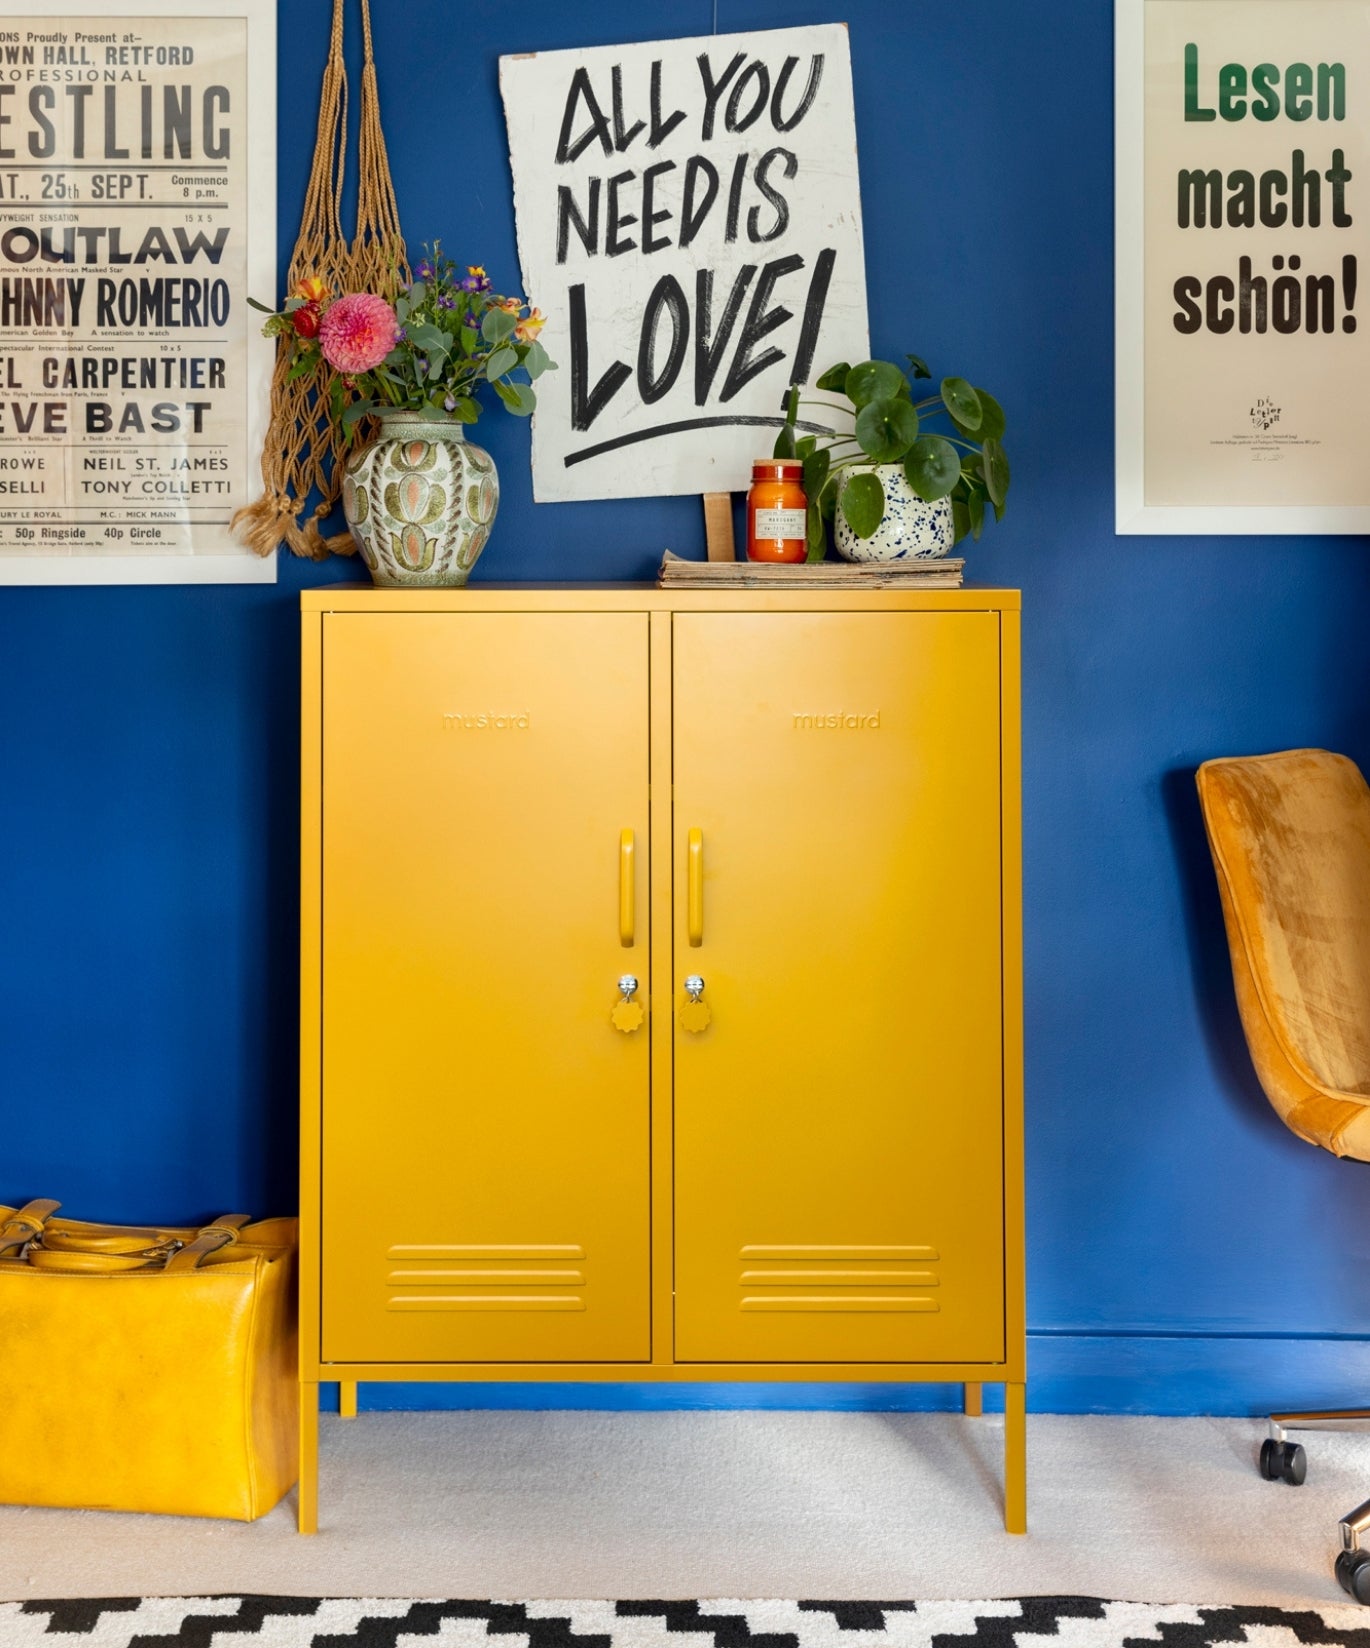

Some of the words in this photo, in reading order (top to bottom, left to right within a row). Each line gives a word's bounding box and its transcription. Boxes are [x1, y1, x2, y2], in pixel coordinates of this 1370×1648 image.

[27, 32, 68, 44] Proudly
[75, 32, 116, 43] Present
[0, 46, 34, 65] WN
[105, 46, 194, 66] RETFORD
[1184, 42, 1345, 122] Lesen
[554, 59, 687, 164] ALL
[696, 51, 825, 141] YOU
[41, 173, 80, 199] 25th
[91, 174, 153, 200] SEPT.
[171, 175, 228, 186] Commence
[1177, 148, 1352, 229] macht
[182, 188, 189, 198] 8
[195, 189, 219, 199] p.m.
[556, 155, 719, 266] NEED
[725, 146, 798, 243] IS
[39, 214, 79, 222] SENSATION
[185, 214, 193, 223] 15
[207, 214, 213, 223] 5
[0, 226, 231, 264] OUTLAW
[2, 277, 85, 327] HNNY
[97, 277, 230, 327] ROMERIO
[1173, 254, 1357, 334] schön!
[568, 248, 836, 432] LOVE!
[43, 357, 226, 389] CARPENTIER
[86, 402, 211, 434] BAST
[0, 458, 45, 470] ROWE
[84, 458, 126, 470] NEIL
[135, 458, 160, 470] ST.
[170, 458, 228, 470] JAMES
[81, 481, 132, 493] TONY
[142, 481, 231, 493] COLLETTI
[15, 527, 35, 539] 50p
[41, 527, 86, 539] Ringside
[104, 527, 124, 539] 40p
[130, 527, 161, 538] Circle
[442, 708, 530, 729] mustard
[792, 708, 881, 729] mustard
